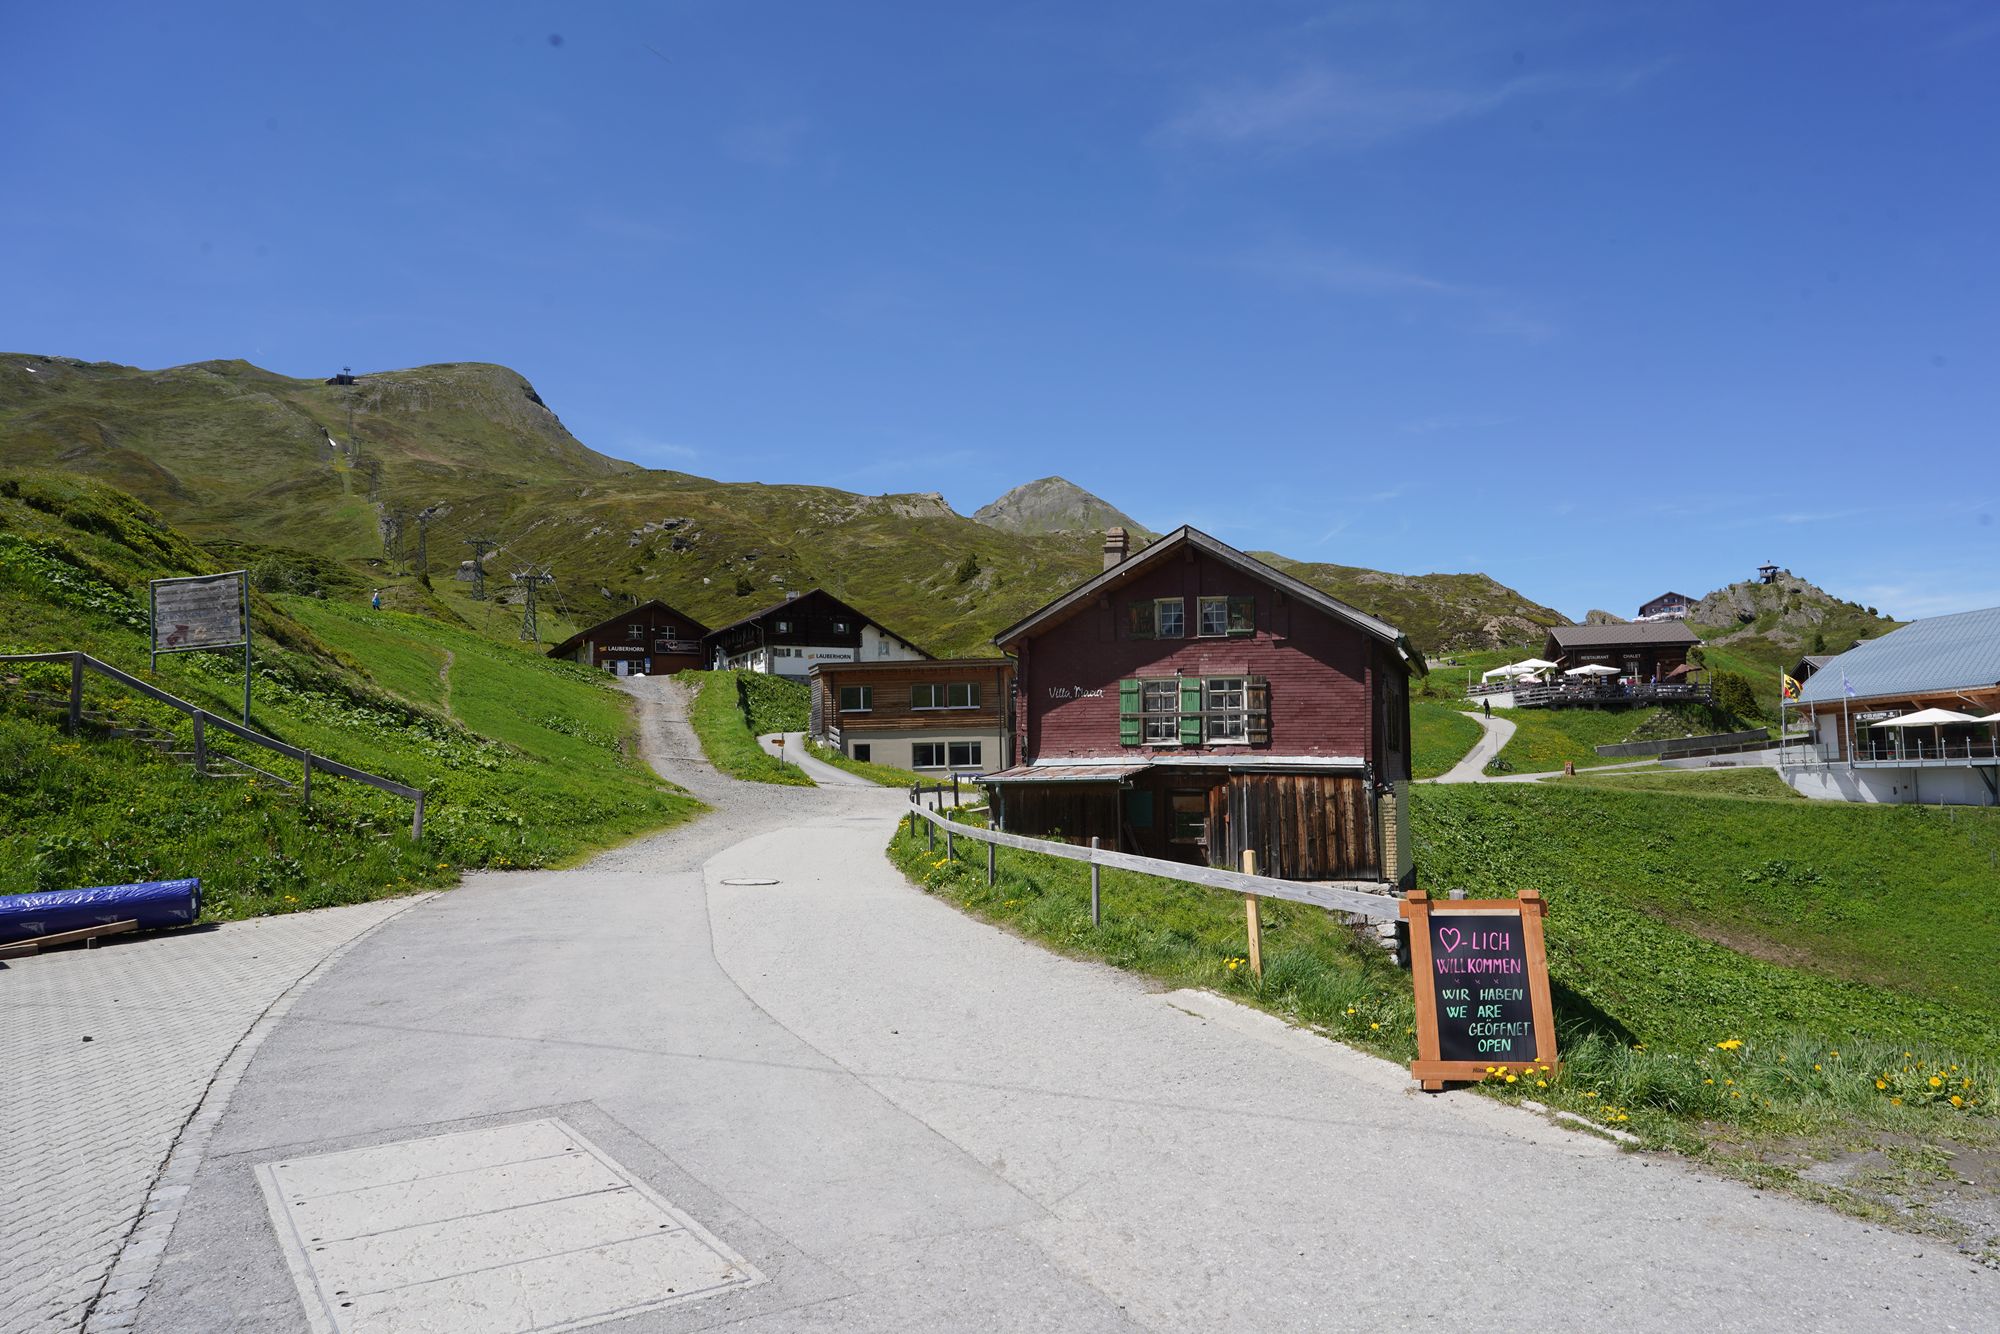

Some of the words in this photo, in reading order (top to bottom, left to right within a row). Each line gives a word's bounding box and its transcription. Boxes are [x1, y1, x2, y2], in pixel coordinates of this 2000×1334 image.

[1048, 686, 1072, 698] Villa
[1436, 958, 1521, 974] WILLKOMMEN
[1442, 988, 1471, 1001] WIR
[1479, 988, 1524, 1001] HABEN
[1446, 1005, 1468, 1018] WE
[1477, 1004, 1503, 1018] ARE
[1468, 1019, 1531, 1037] GEÖFFNET
[1478, 1038, 1511, 1053] OPEN
